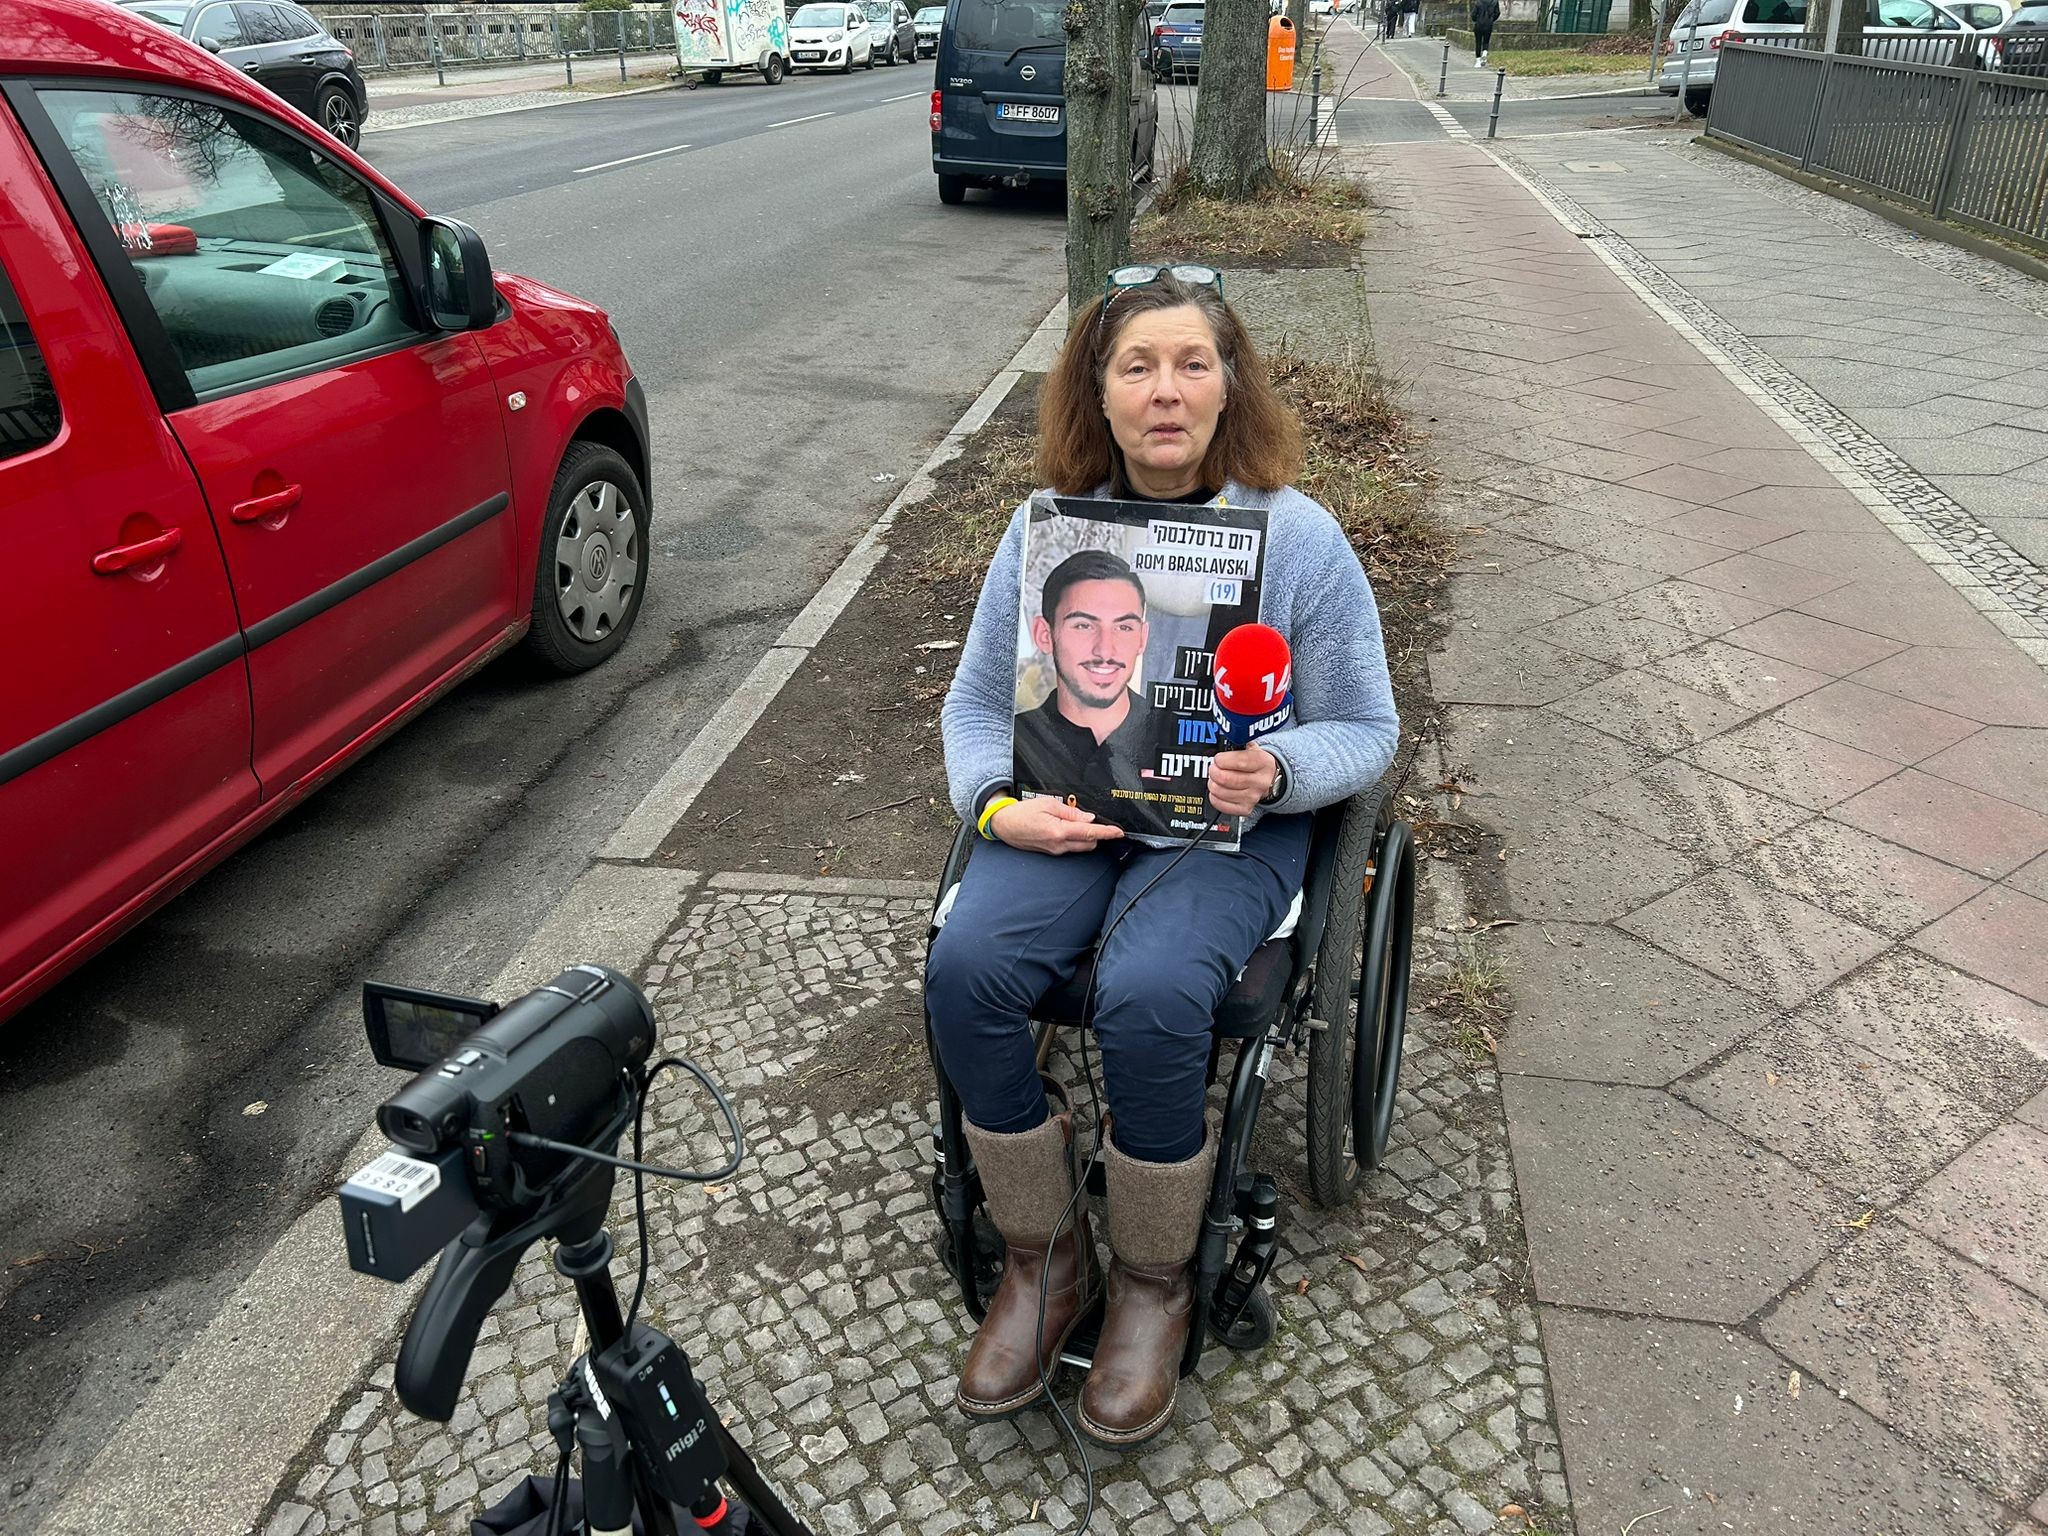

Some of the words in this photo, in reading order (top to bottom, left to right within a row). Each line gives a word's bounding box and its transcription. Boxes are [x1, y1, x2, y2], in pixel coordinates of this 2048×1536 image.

[1003, 104, 1010, 116] B
[1016, 106, 1031, 117] FF
[1031, 106, 1059, 119] 8607
[1153, 525, 1224, 548] ברסלבסקי
[1228, 533, 1253, 551] רום
[1135, 553, 1165, 570] ROM
[1168, 555, 1249, 576] BRASLAVSKI
[1210, 582, 1236, 602] (19)
[1185, 650, 1214, 677] דיון
[1154, 685, 1214, 711] שבויים
[1178, 719, 1219, 745] צחון
[1249, 704, 1290, 737] עכשיו
[1161, 753, 1215, 778] מדינה
[584, 1358, 612, 1421] HURE
[664, 1436, 695, 1462] iRig
[696, 1418, 707, 1433] 2
